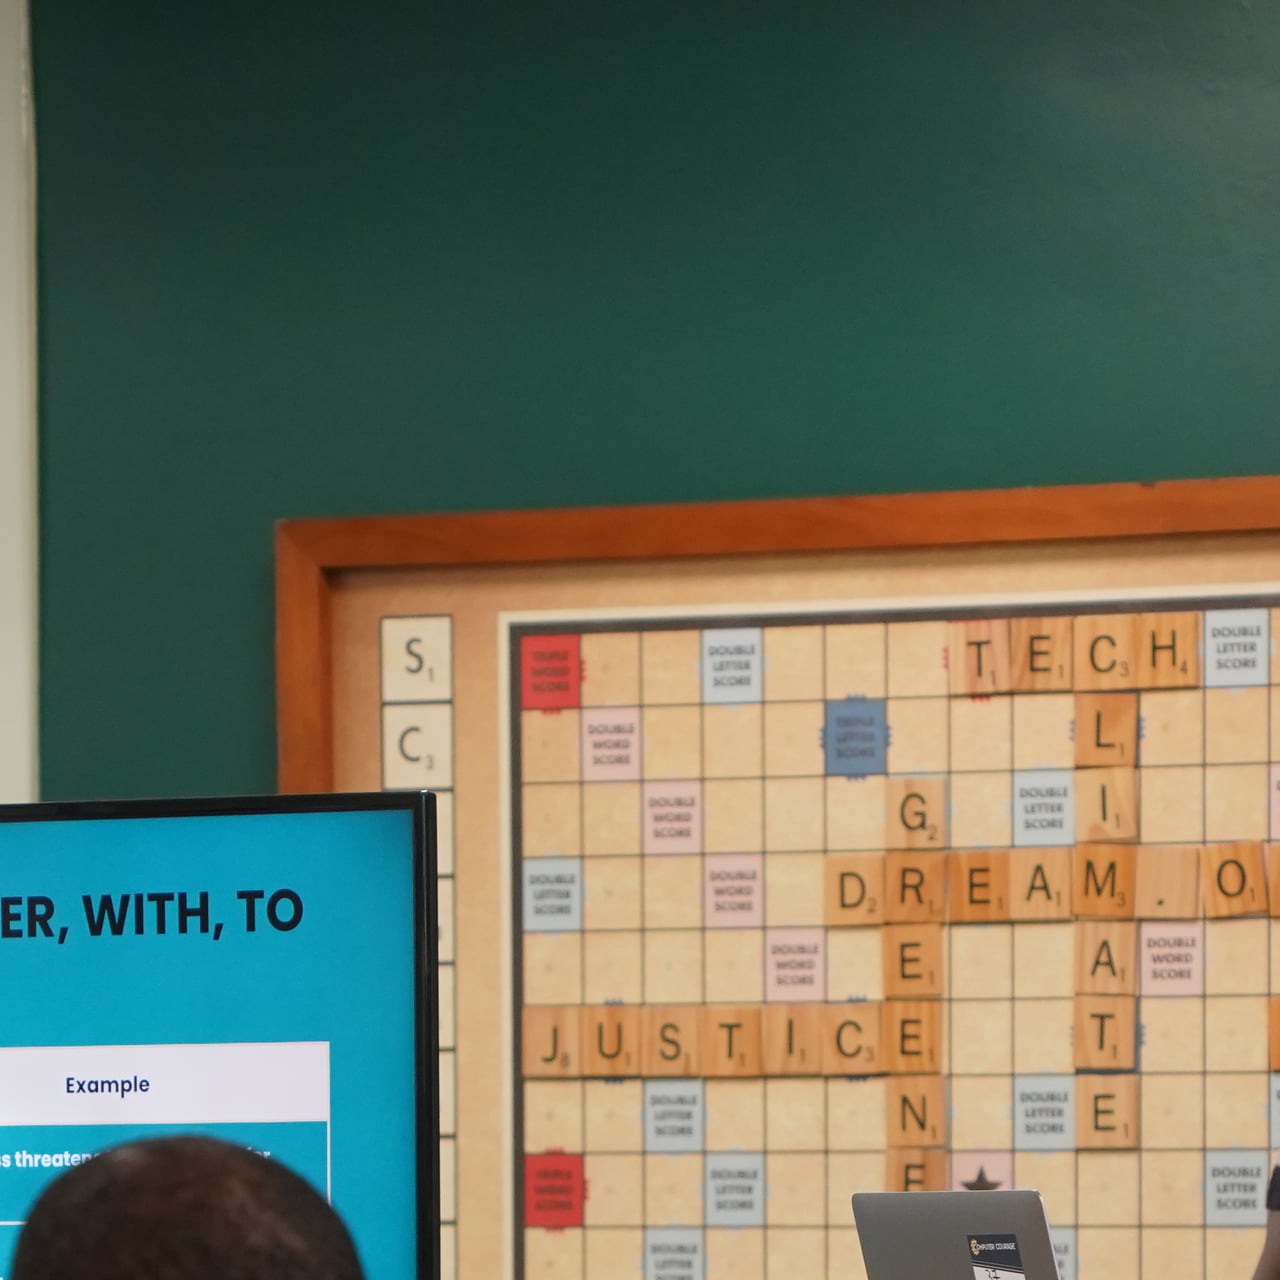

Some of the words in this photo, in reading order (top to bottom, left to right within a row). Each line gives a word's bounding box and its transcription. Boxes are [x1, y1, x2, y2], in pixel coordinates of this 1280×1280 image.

[1211, 625, 1261, 639] DOUBLE
[708, 645, 755, 657] DOUBLE
[1216, 641, 1257, 654] LETTER
[713, 660, 751, 672] LETTER
[1216, 657, 1257, 670] SCORE
[713, 676, 751, 687] SCORE
[588, 724, 634, 735] DOUBLE
[592, 739, 631, 750] WORD
[592, 754, 631, 765] SCORE
[1019, 787, 1068, 799] DOUBLE
[1024, 802, 1063, 814] LETTER
[1024, 818, 1063, 830] SCORE
[82, 891, 223, 941] WITH,
[236, 888, 304, 932] TO
[1147, 937, 1196, 949] DOUBLE
[1152, 953, 1193, 965] WORD
[1152, 968, 1192, 980] SCORE
[66, 1076, 150, 1099] Example
[1020, 1091, 1068, 1103] DOUBLE
[1025, 1107, 1064, 1118] LETTER
[1025, 1123, 1064, 1134] SCORE
[1212, 1167, 1261, 1179] DOUBLE
[1216, 1182, 1257, 1194] LETTER
[1216, 1198, 1258, 1210] SCORE
